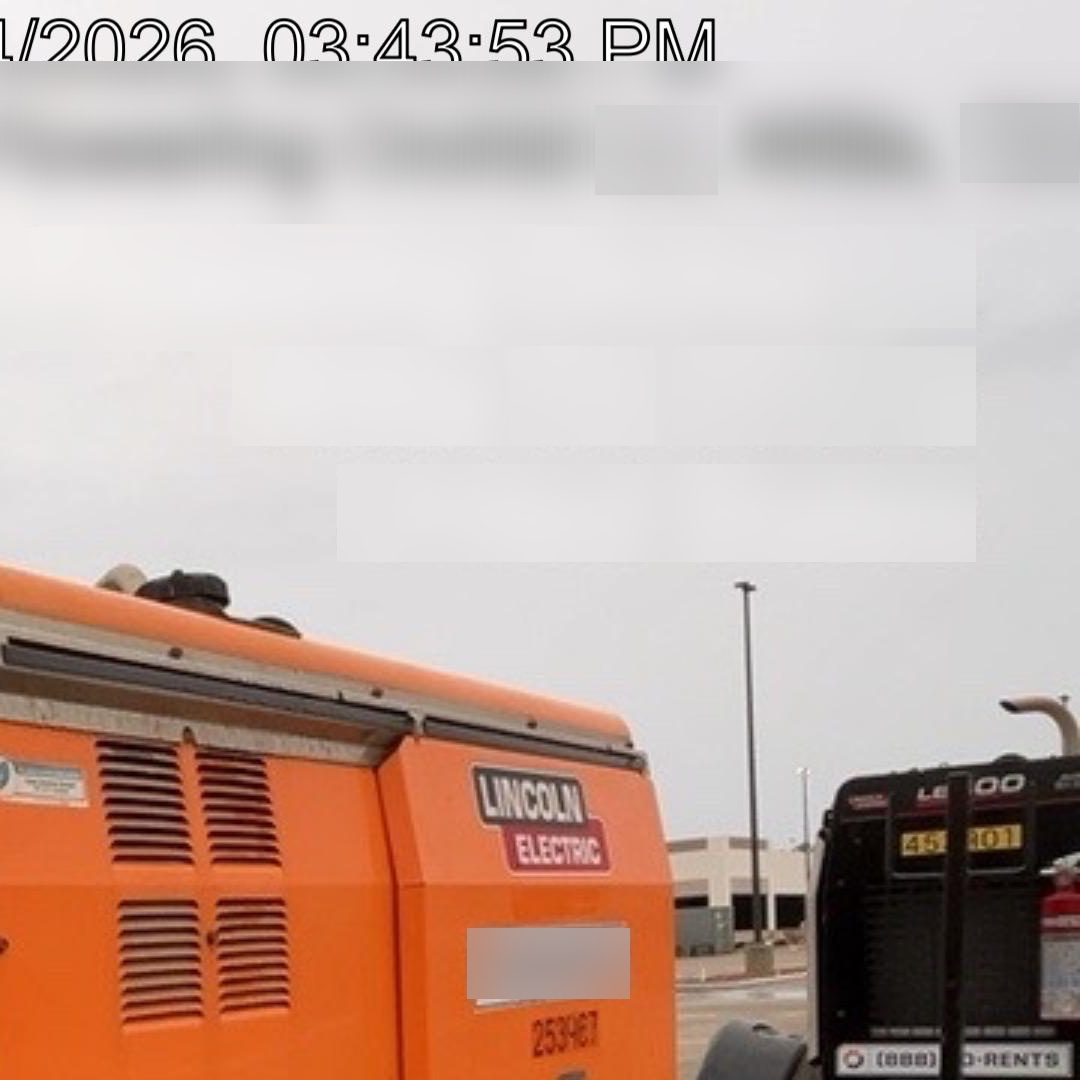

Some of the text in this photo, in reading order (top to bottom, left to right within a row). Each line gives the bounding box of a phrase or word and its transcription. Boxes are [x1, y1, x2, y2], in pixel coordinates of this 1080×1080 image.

[479, 774, 584, 823] LINCOLN
[917, 773, 1026, 801] LE00
[514, 833, 601, 865] ELECTRIC
